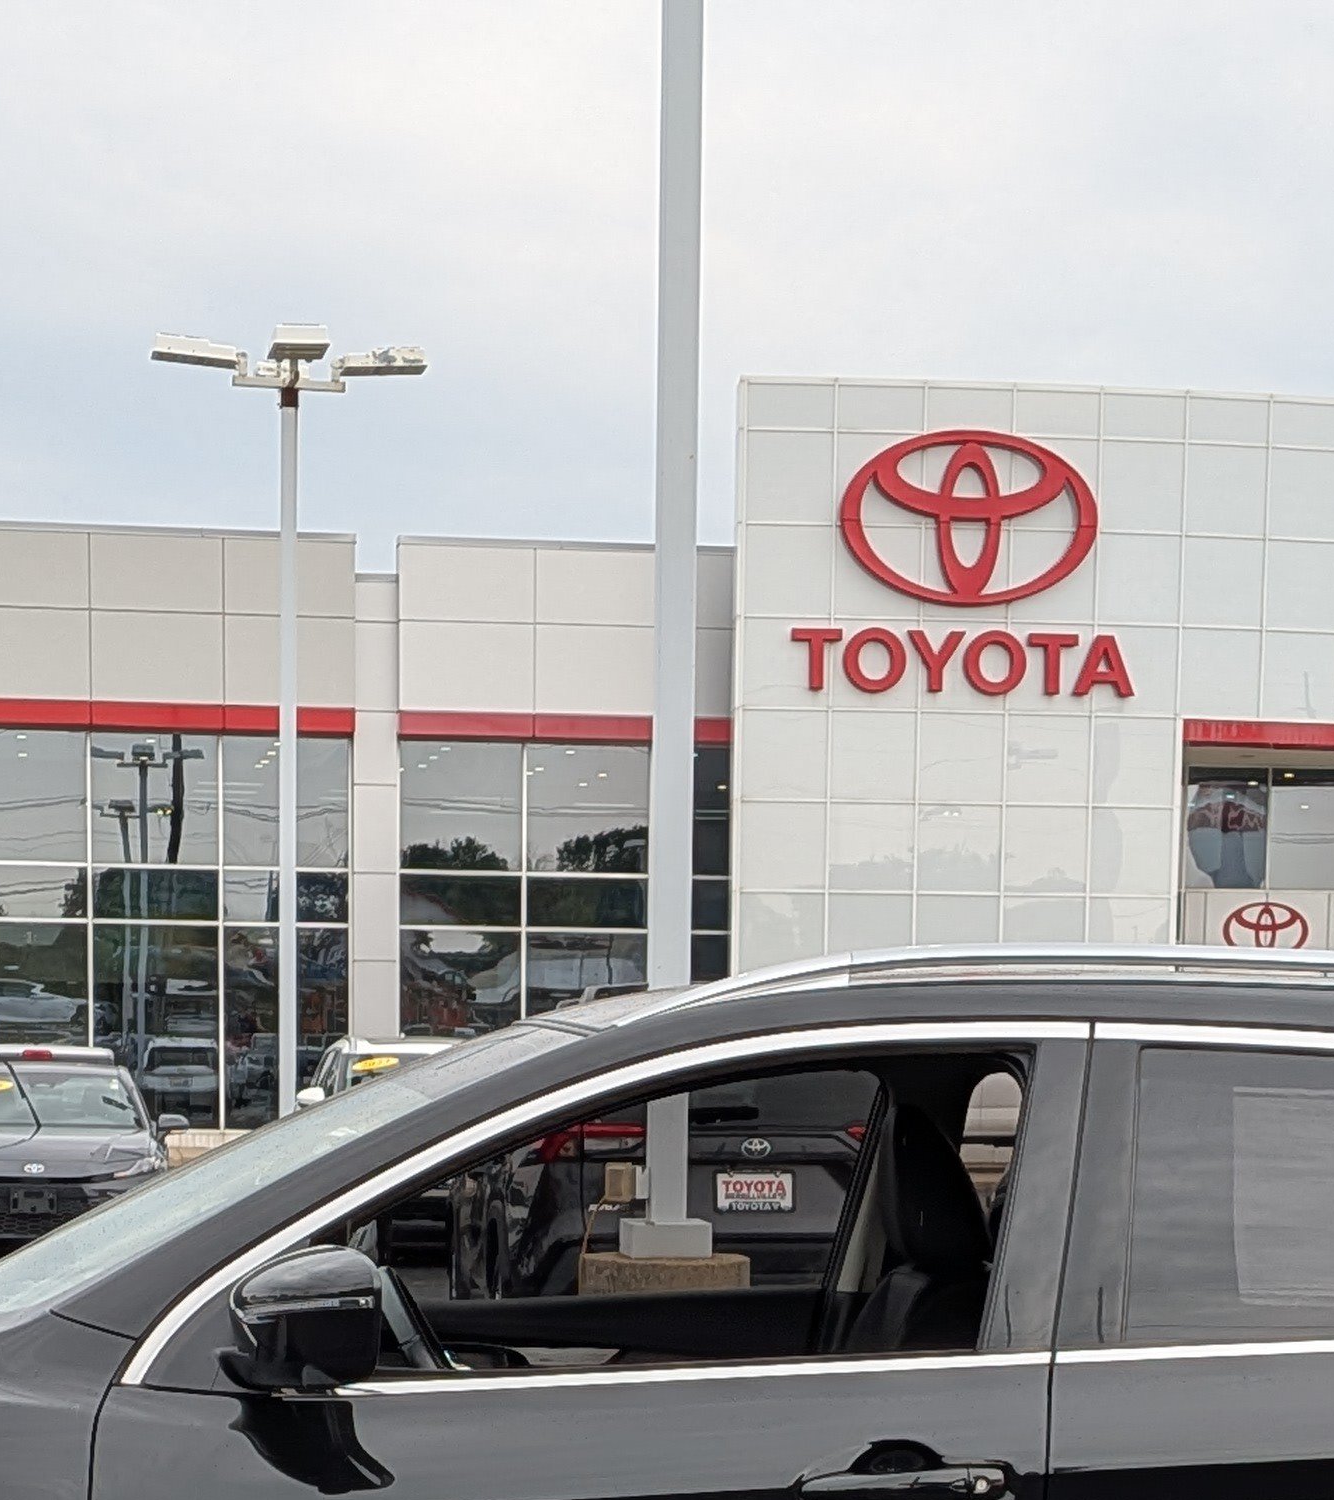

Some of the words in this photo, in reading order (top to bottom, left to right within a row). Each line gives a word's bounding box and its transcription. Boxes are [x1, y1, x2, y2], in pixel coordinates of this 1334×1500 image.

[791, 627, 1135, 698] TOYOTA
[722, 1180, 786, 1195] TOYOTA
[731, 1202, 772, 1211] TOYOTA
